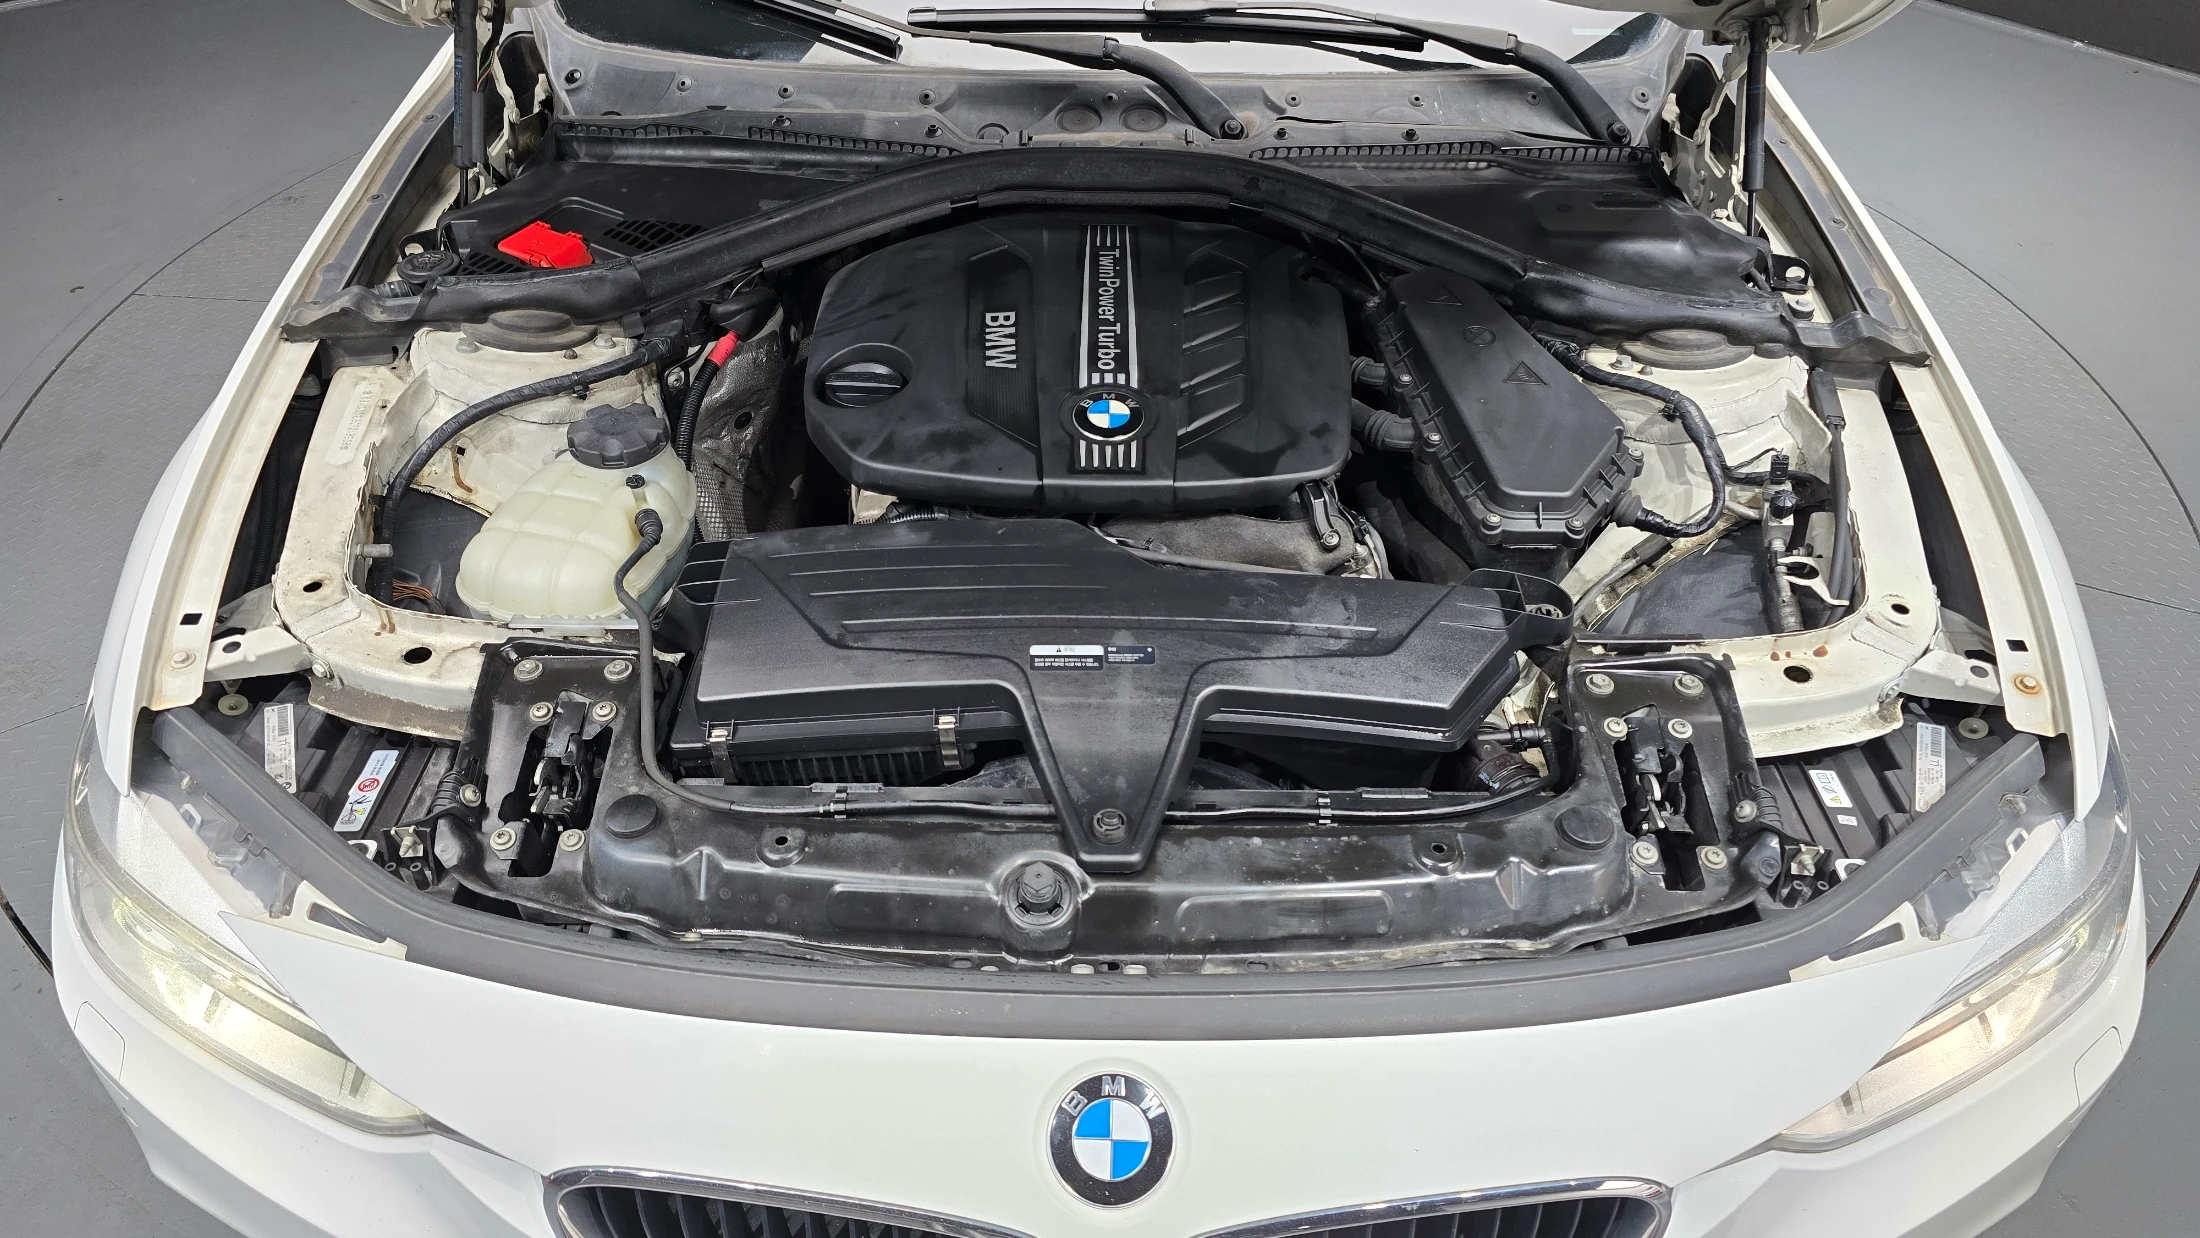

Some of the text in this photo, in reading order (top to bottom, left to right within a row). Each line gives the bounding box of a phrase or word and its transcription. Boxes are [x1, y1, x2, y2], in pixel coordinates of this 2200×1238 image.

[1097, 249, 1121, 370] TwinPower Turbo
[985, 311, 1017, 369] BMW
[1080, 393, 1139, 408] BMW
[1061, 1075, 1166, 1120] BMW
